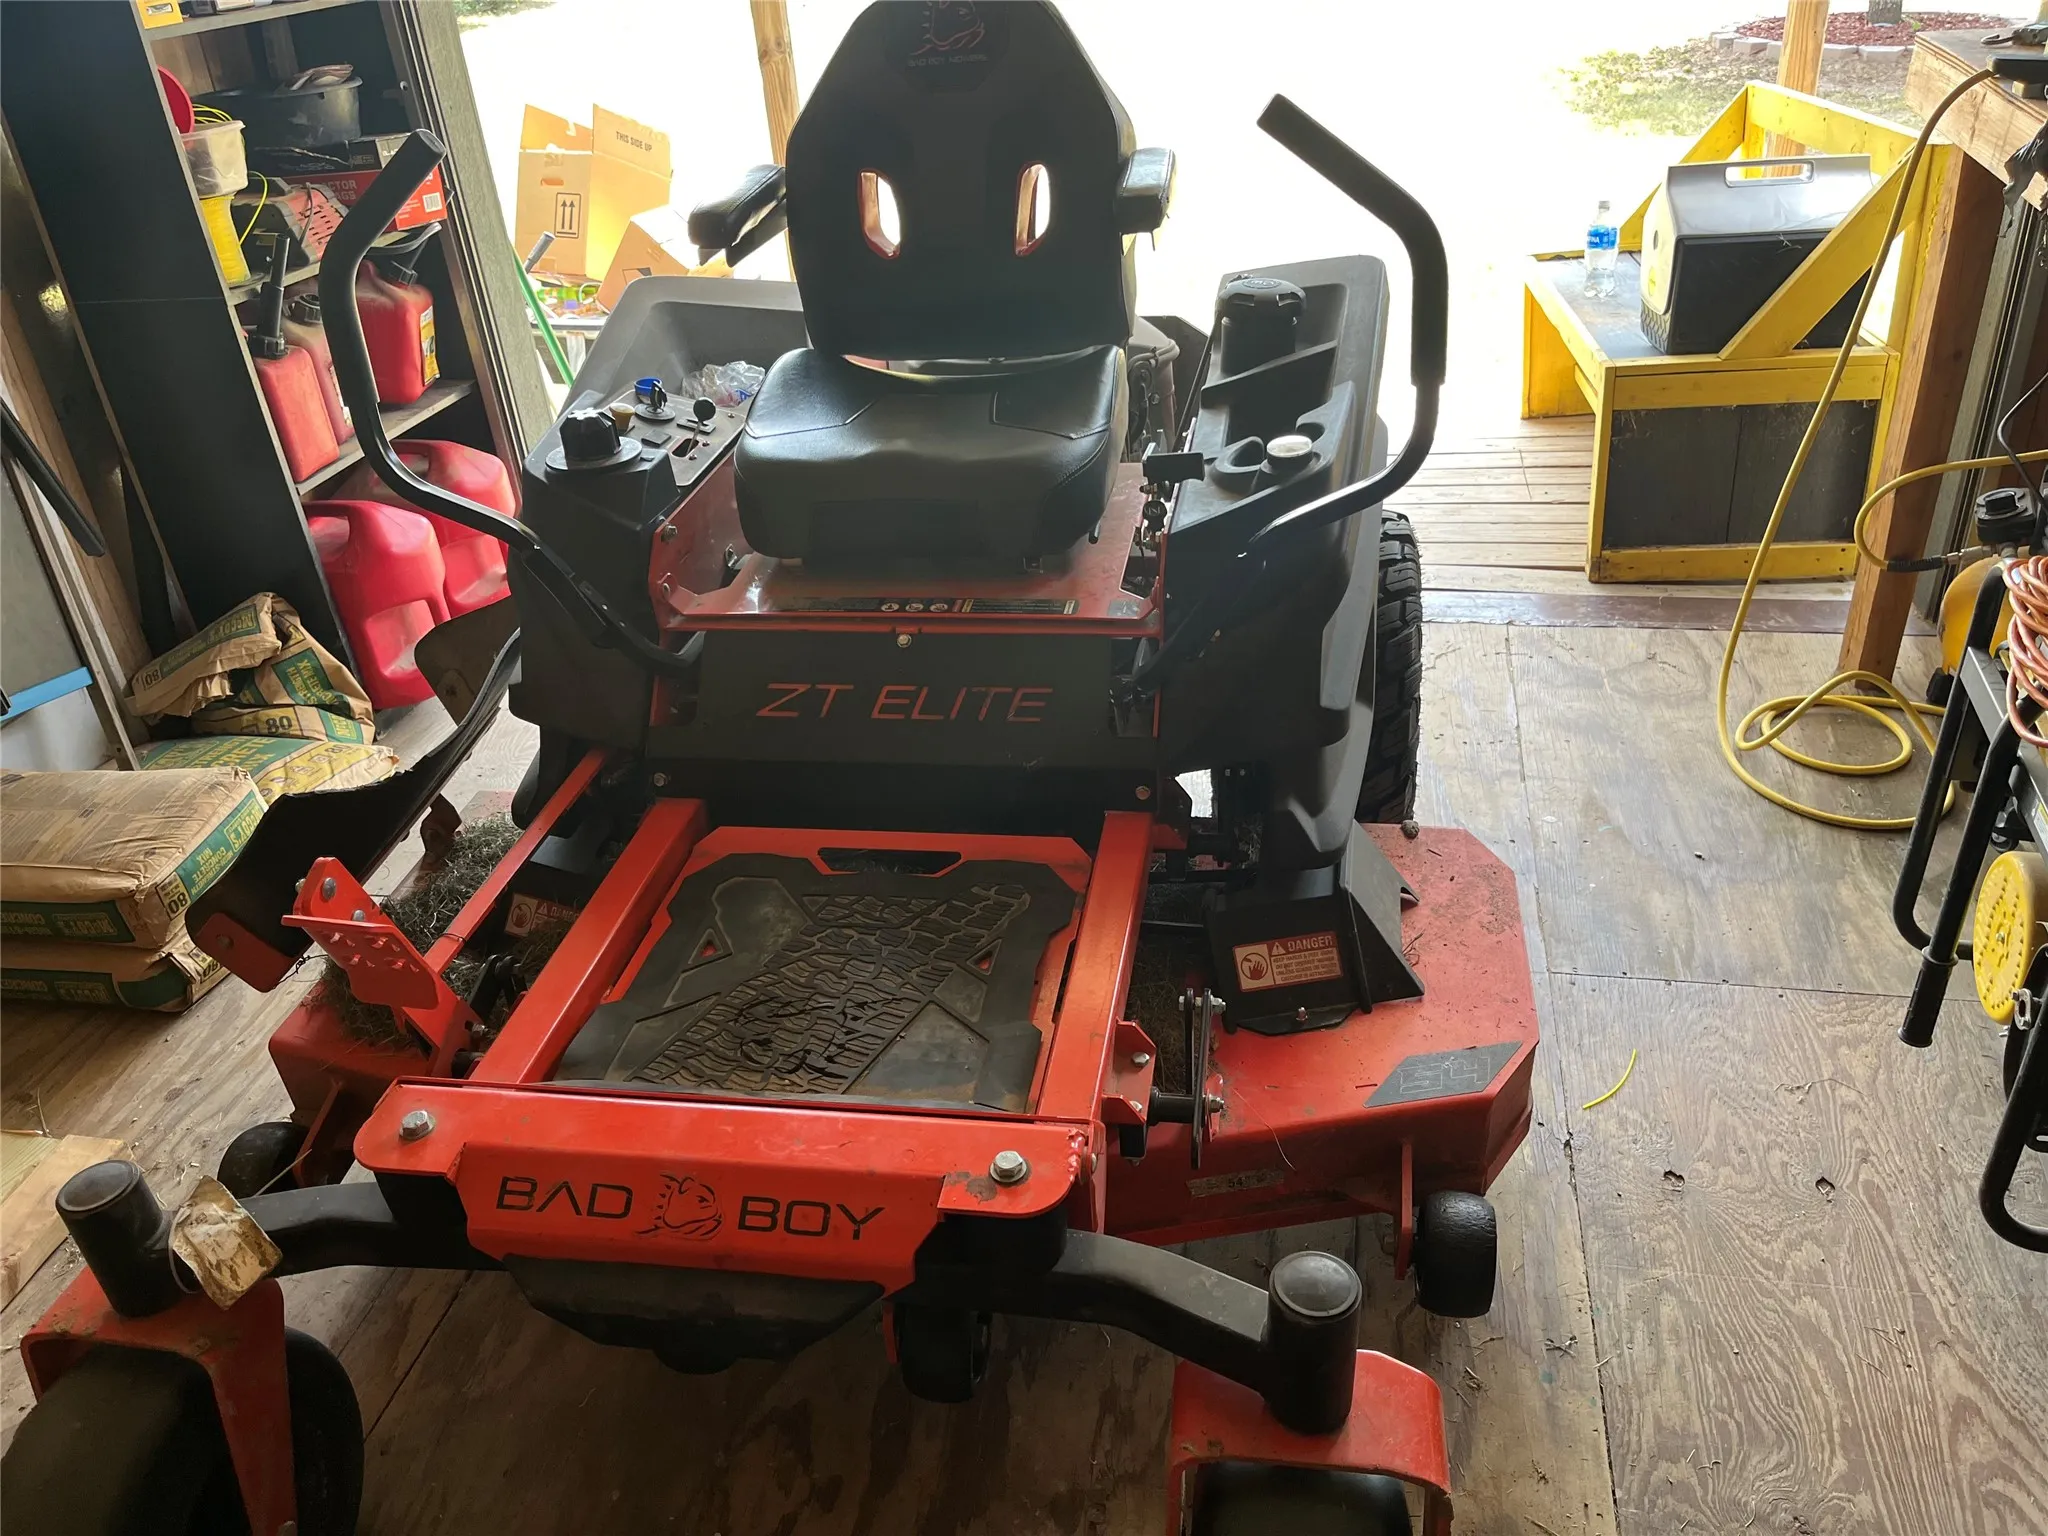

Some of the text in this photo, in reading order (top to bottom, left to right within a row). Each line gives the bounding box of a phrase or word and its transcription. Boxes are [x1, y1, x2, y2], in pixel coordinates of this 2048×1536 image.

[616, 131, 653, 152] THIS SIDE UP
[756, 683, 1053, 723] ZT ELITE
[265, 715, 294, 734] 80
[192, 846, 227, 883] CONCRETE
[196, 847, 214, 866] MIX
[168, 892, 188, 914] 80
[1287, 935, 1333, 952] DANGER
[1397, 1056, 1491, 1095] 54
[496, 1176, 885, 1241] BAD BOY
